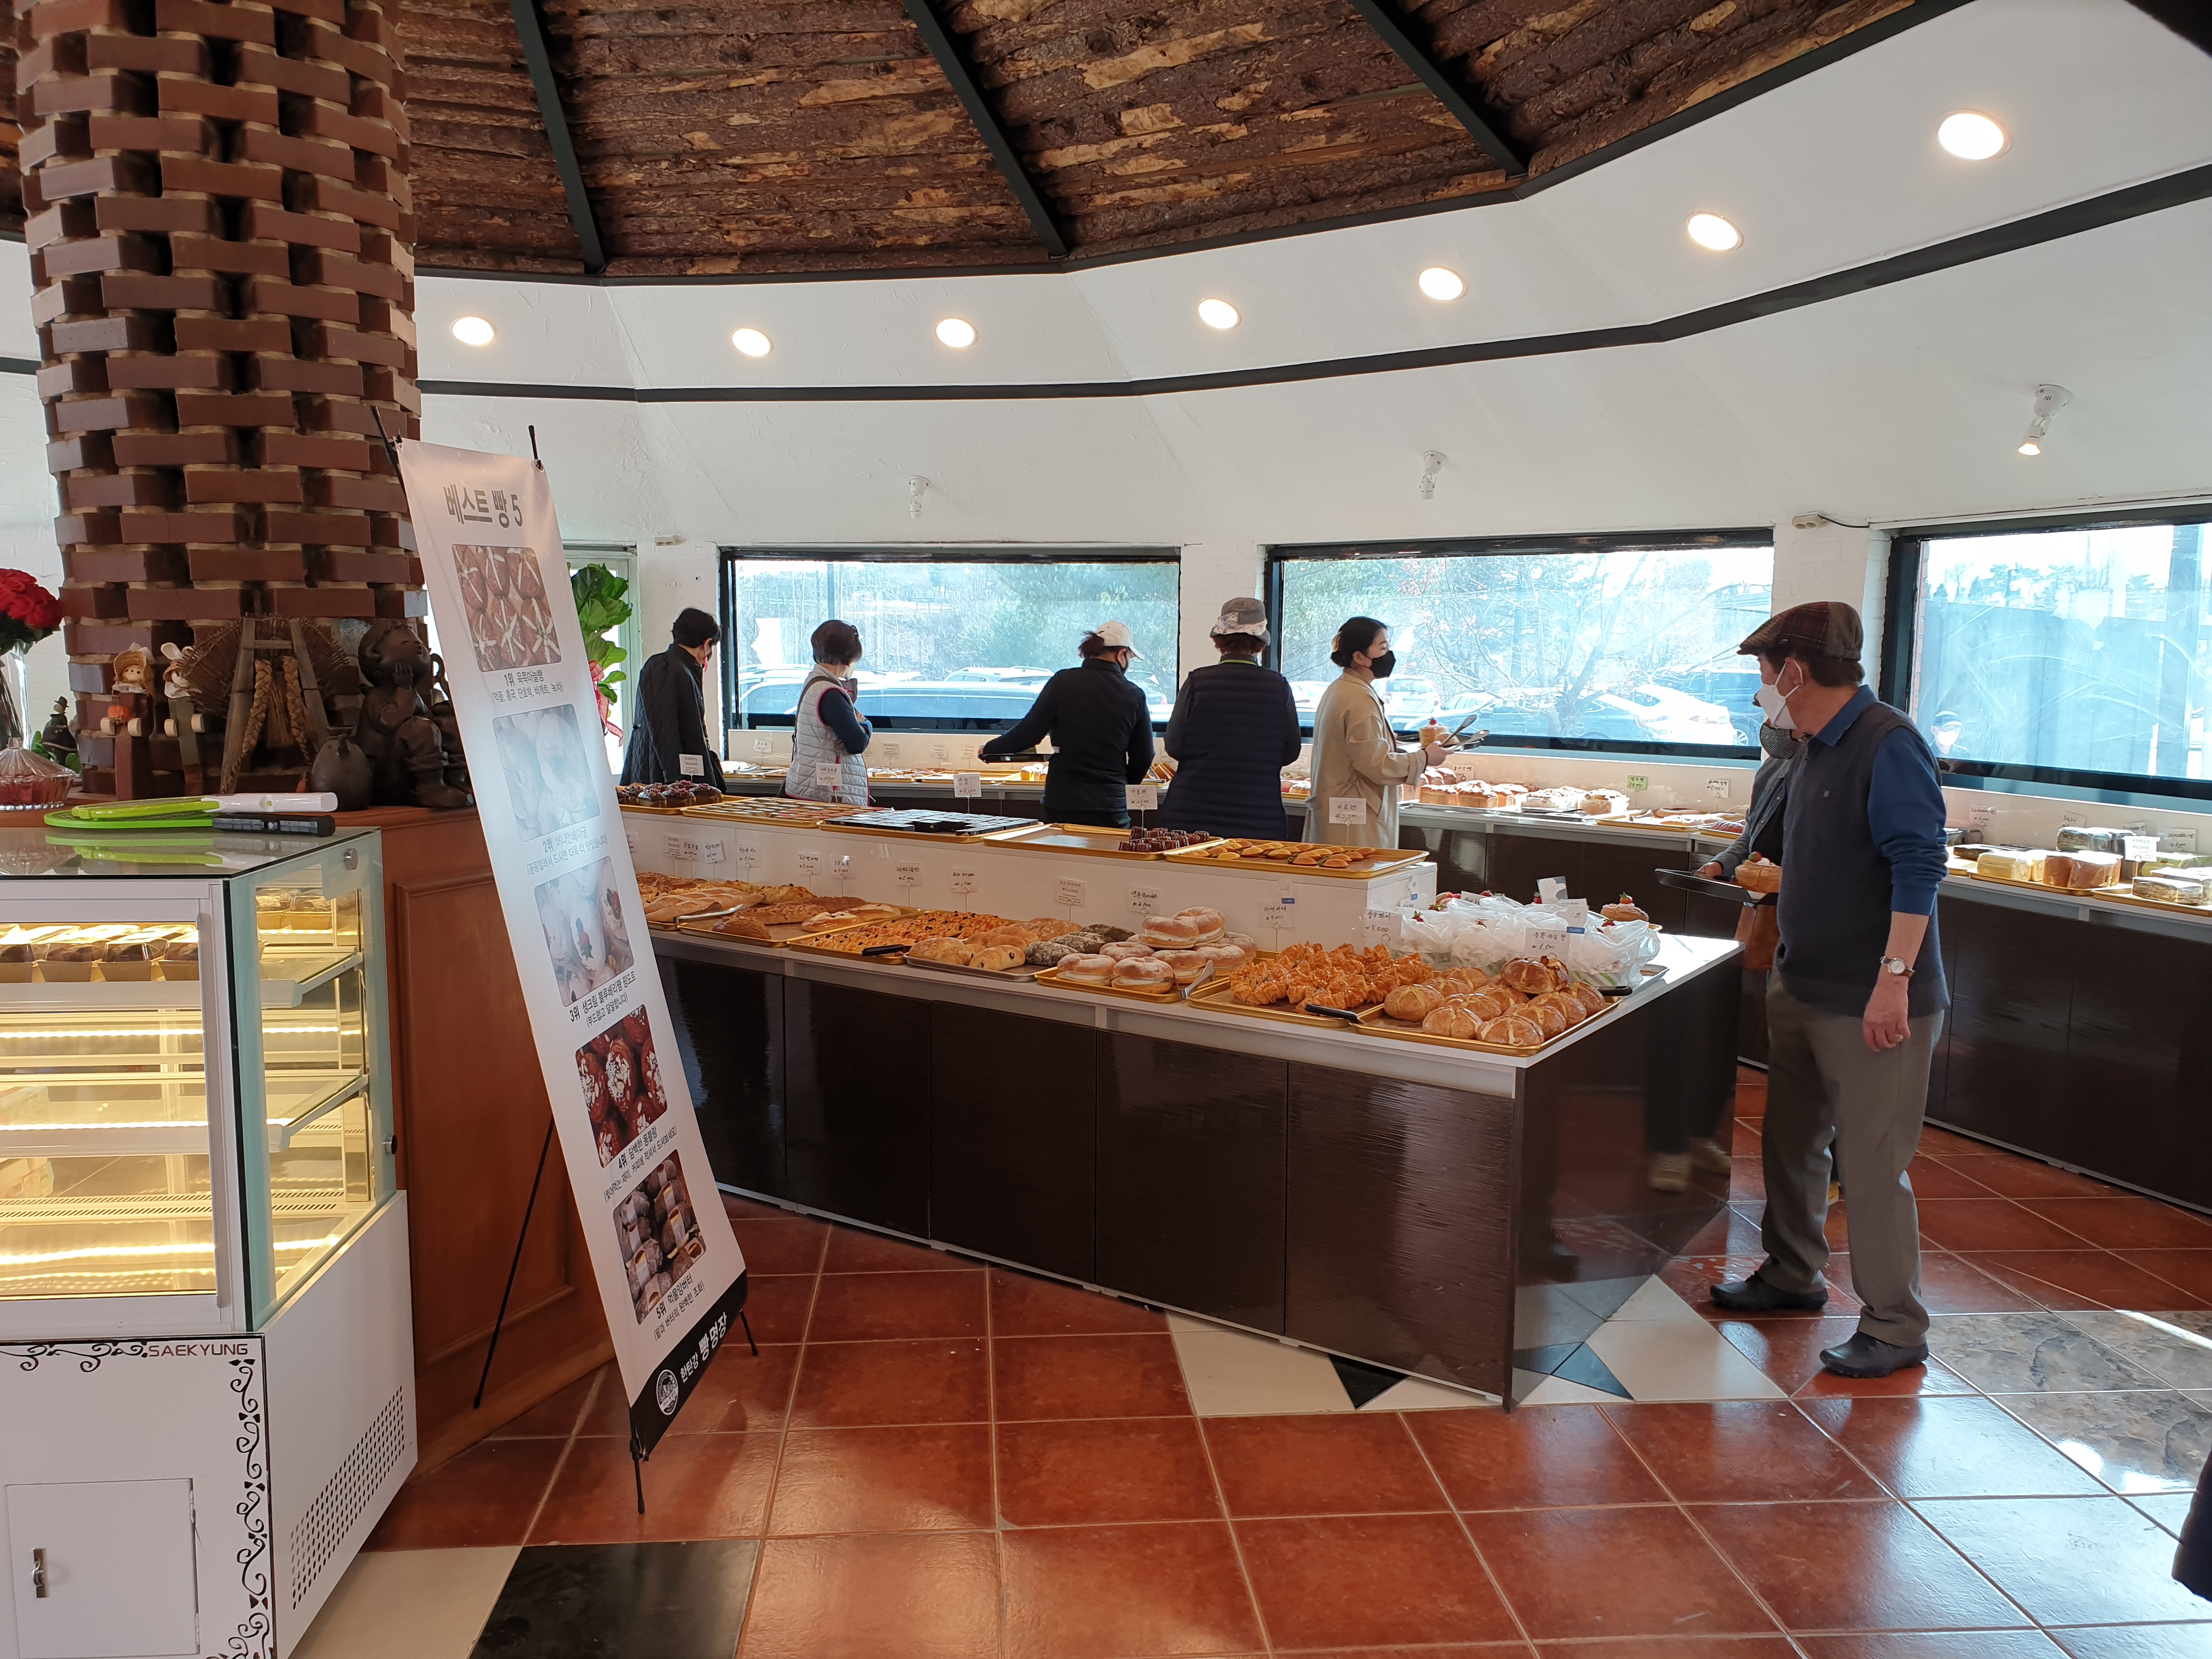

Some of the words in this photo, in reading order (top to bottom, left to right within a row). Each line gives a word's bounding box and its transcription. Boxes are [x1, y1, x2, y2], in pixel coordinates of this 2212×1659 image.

[443, 483, 493, 524] 베스트
[492, 489, 510, 528] 빵
[511, 494, 523, 527] 5
[504, 673, 515, 687] 1위
[517, 669, 544, 684] 육쪽마늘빵
[543, 838, 554, 853] 2위
[556, 826, 588, 847] 어니언베이글
[569, 1005, 580, 1022] 3위
[582, 994, 598, 1014] 생크림
[622, 971, 636, 988] 팡도르
[586, 1008, 606, 1028] (부드럽고
[606, 992, 628, 1014] 달달합니다)
[618, 1153, 628, 1169] 4위
[629, 1138, 643, 1159] 담백한
[643, 1126, 657, 1147] 몽블랑
[631, 1155, 645, 1173] 커피에
[644, 1144, 657, 1160] 적셔서
[657, 1125, 678, 1150] 드셔보세요)
[656, 1300, 667, 1319] 5위
[667, 1273, 693, 1303] 먹물앙버터
[665, 1310, 679, 1327] 버터의
[679, 1294, 694, 1312] 완벽한
[693, 1280, 706, 1298] 조화)
[148, 1344, 248, 1357] SAEKYUNG
[680, 1352, 699, 1383] 한탄강
[699, 1312, 727, 1361] 빵명장
